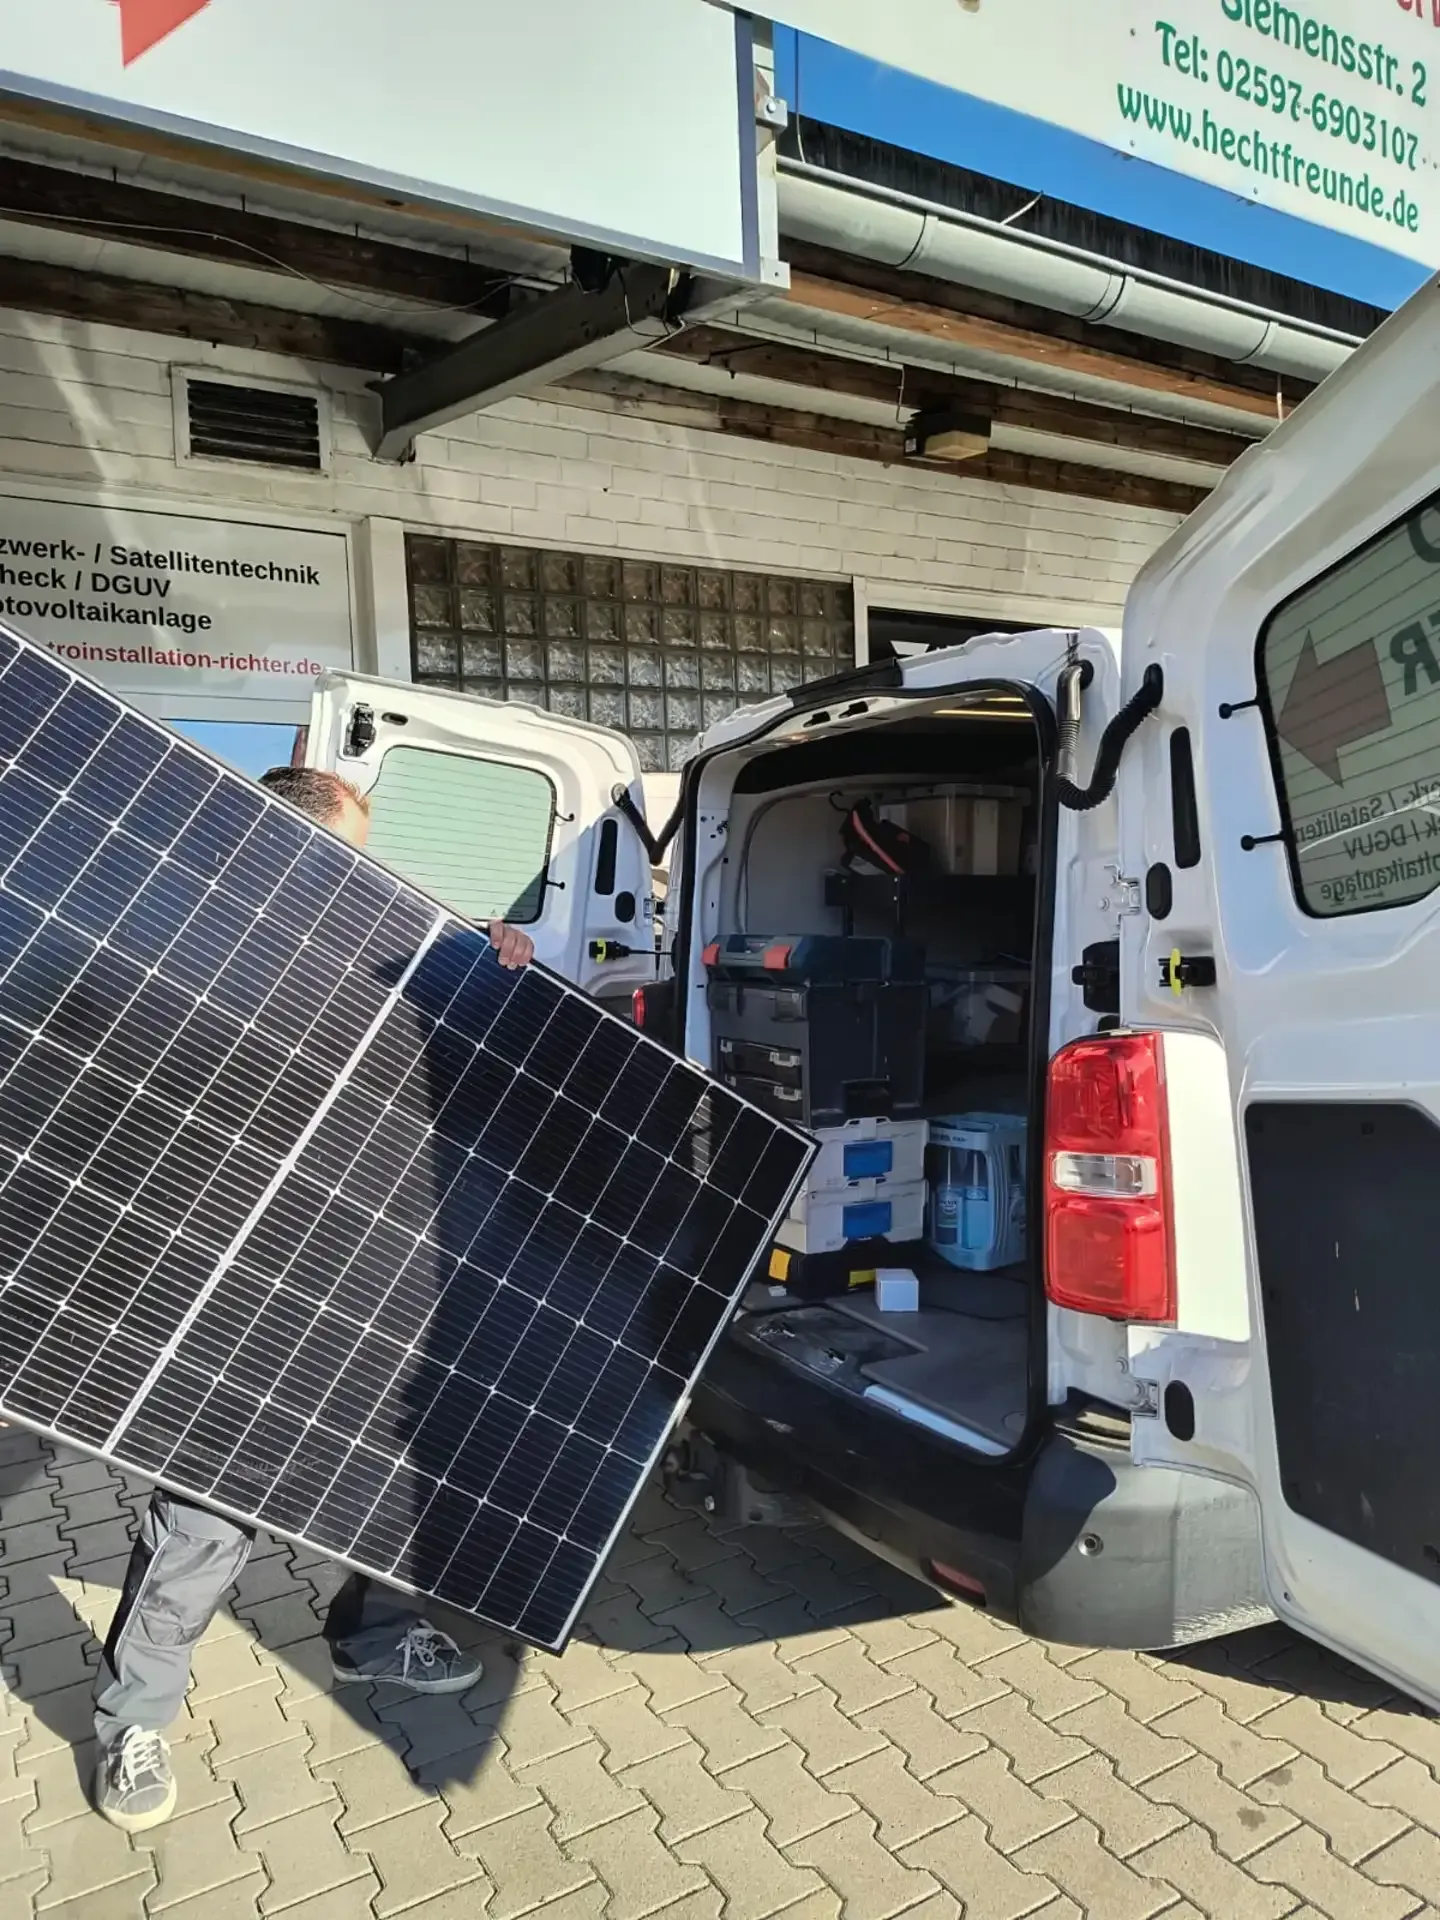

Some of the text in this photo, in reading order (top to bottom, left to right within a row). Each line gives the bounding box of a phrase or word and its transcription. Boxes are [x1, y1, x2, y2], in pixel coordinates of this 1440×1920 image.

[1155, 20, 1419, 170] Tel: 02597-6903107
[1411, 60, 1427, 106] 2
[1117, 83, 1419, 233] www.hechtfreunde.de
[74, 570, 82, 591] /
[91, 572, 171, 598] DGUV
[94, 542, 102, 564] /
[110, 545, 320, 585] Satellitentechnik
[0, 596, 212, 633] tovoltaikanlage
